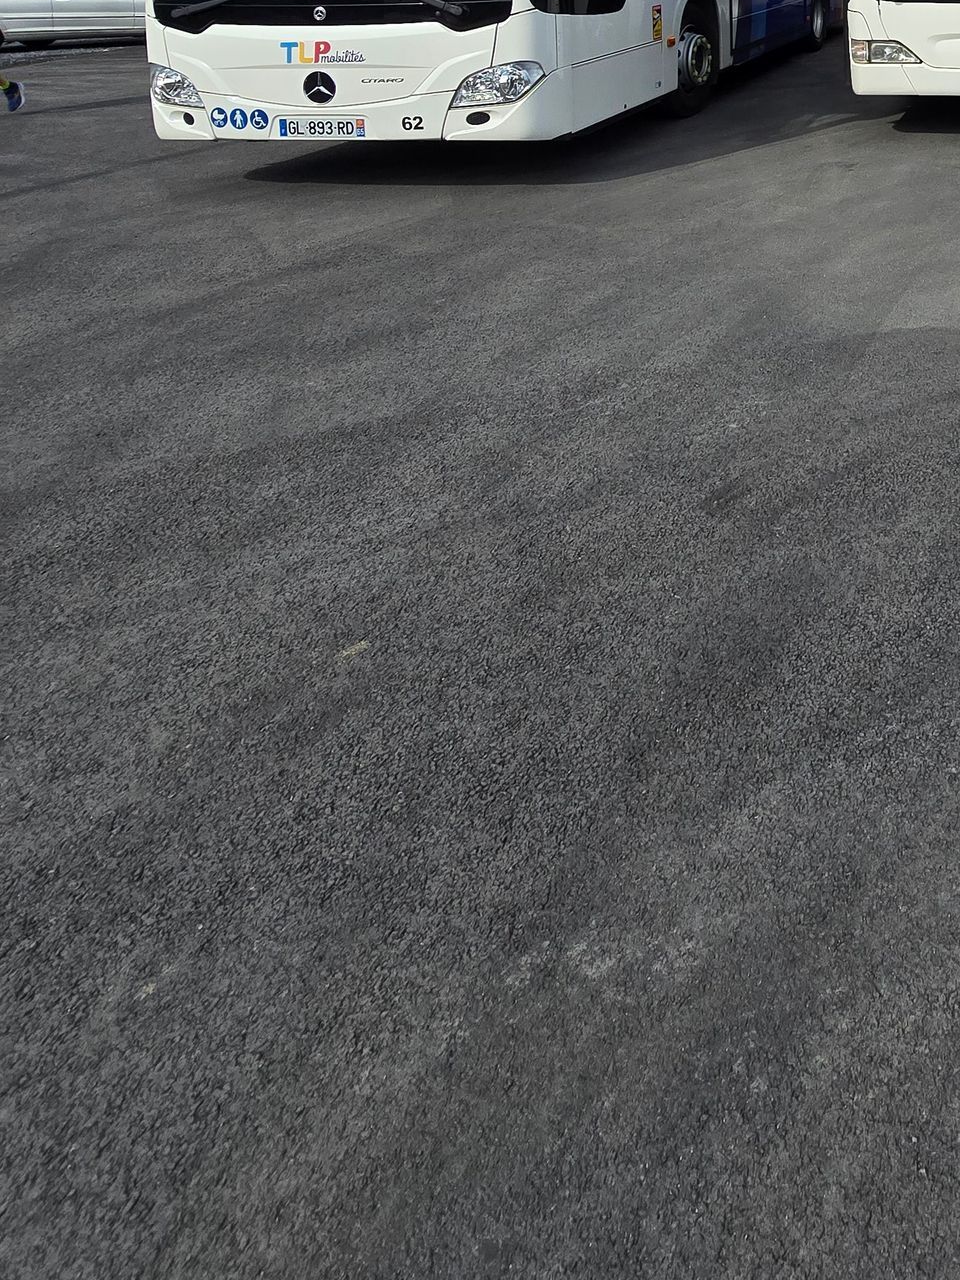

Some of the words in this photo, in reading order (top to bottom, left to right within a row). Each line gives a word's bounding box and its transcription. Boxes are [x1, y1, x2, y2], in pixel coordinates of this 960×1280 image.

[280, 41, 331, 64] TLP
[320, 49, 366, 64] mobilités
[288, 120, 354, 136] GL-893-RD
[401, 116, 425, 131] 62
